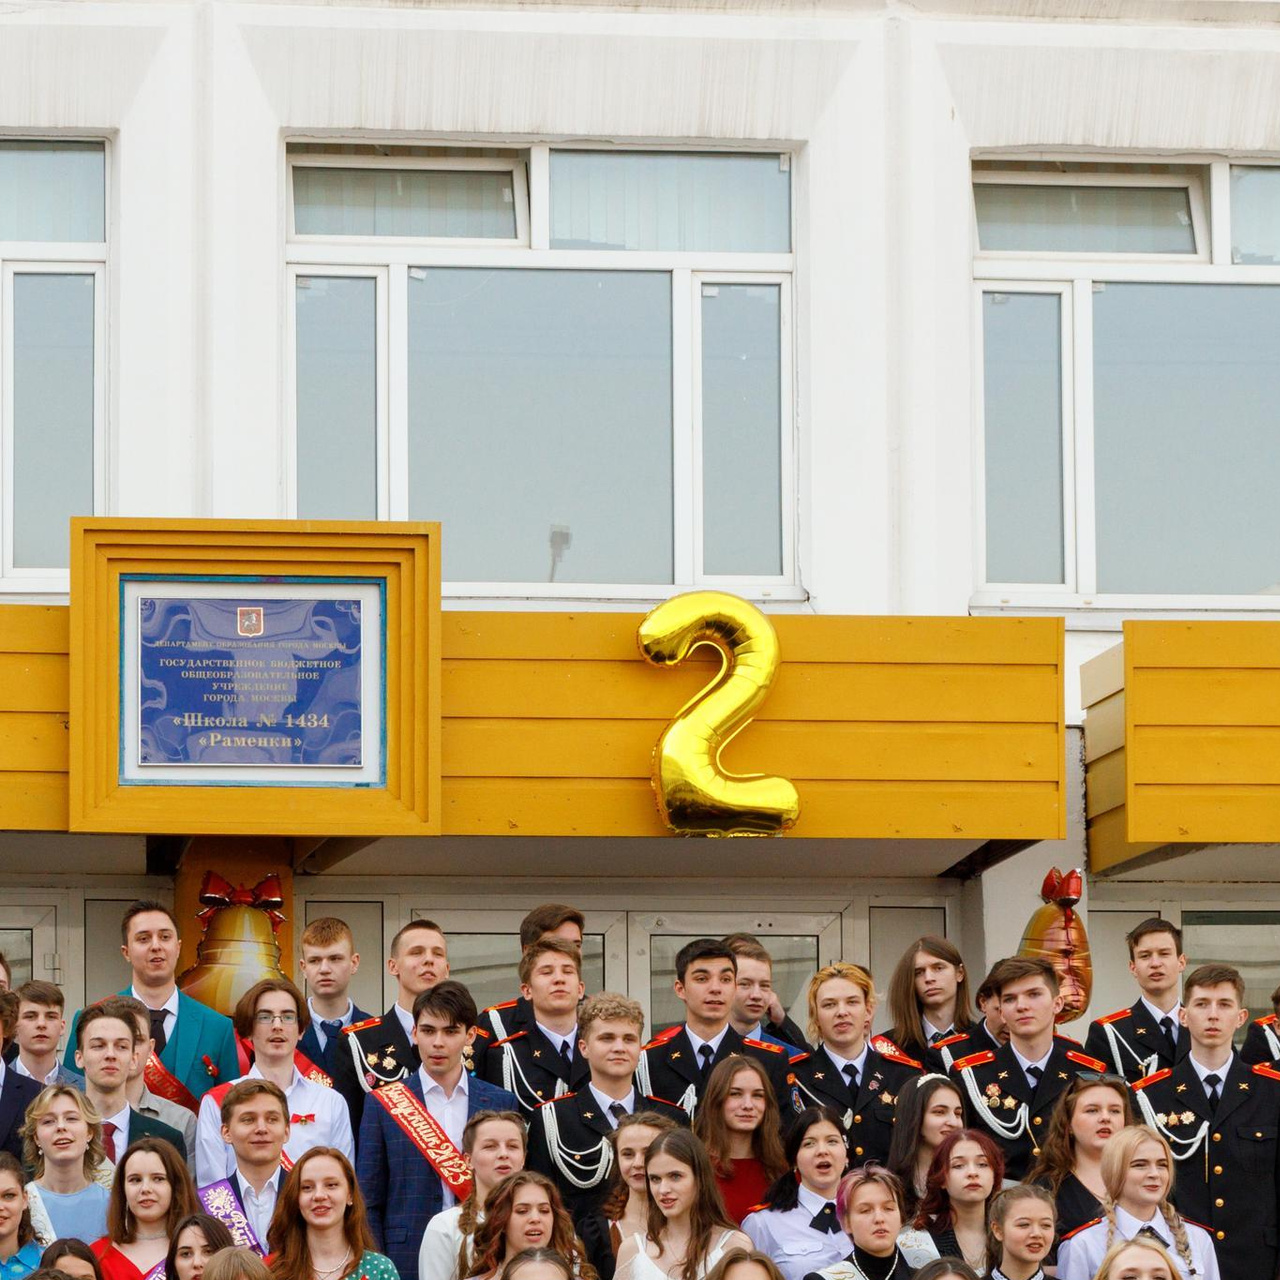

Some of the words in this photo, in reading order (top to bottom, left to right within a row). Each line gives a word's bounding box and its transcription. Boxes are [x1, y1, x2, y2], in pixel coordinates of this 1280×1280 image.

[159, 659, 265, 669] ГОСУДАРСТВЕННОЕ
[270, 660, 341, 669] БЮДЖЕТНОЕ
[181, 671, 319, 680] ОБЩЕОБРАЗОВАТЕЛЬНОЕ
[212, 682, 288, 691] УЧРЕЖДЕНИЕ
[203, 694, 245, 702] ГОРОДА
[251, 694, 297, 703] МОСКВЫ
[638, 590, 800, 836] 2
[173, 712, 248, 728] «Школа
[256, 713, 276, 728] №
[285, 713, 330, 728] 1434
[198, 732, 302, 748] «Раменки»
[427, 1142, 473, 1185] 2023
